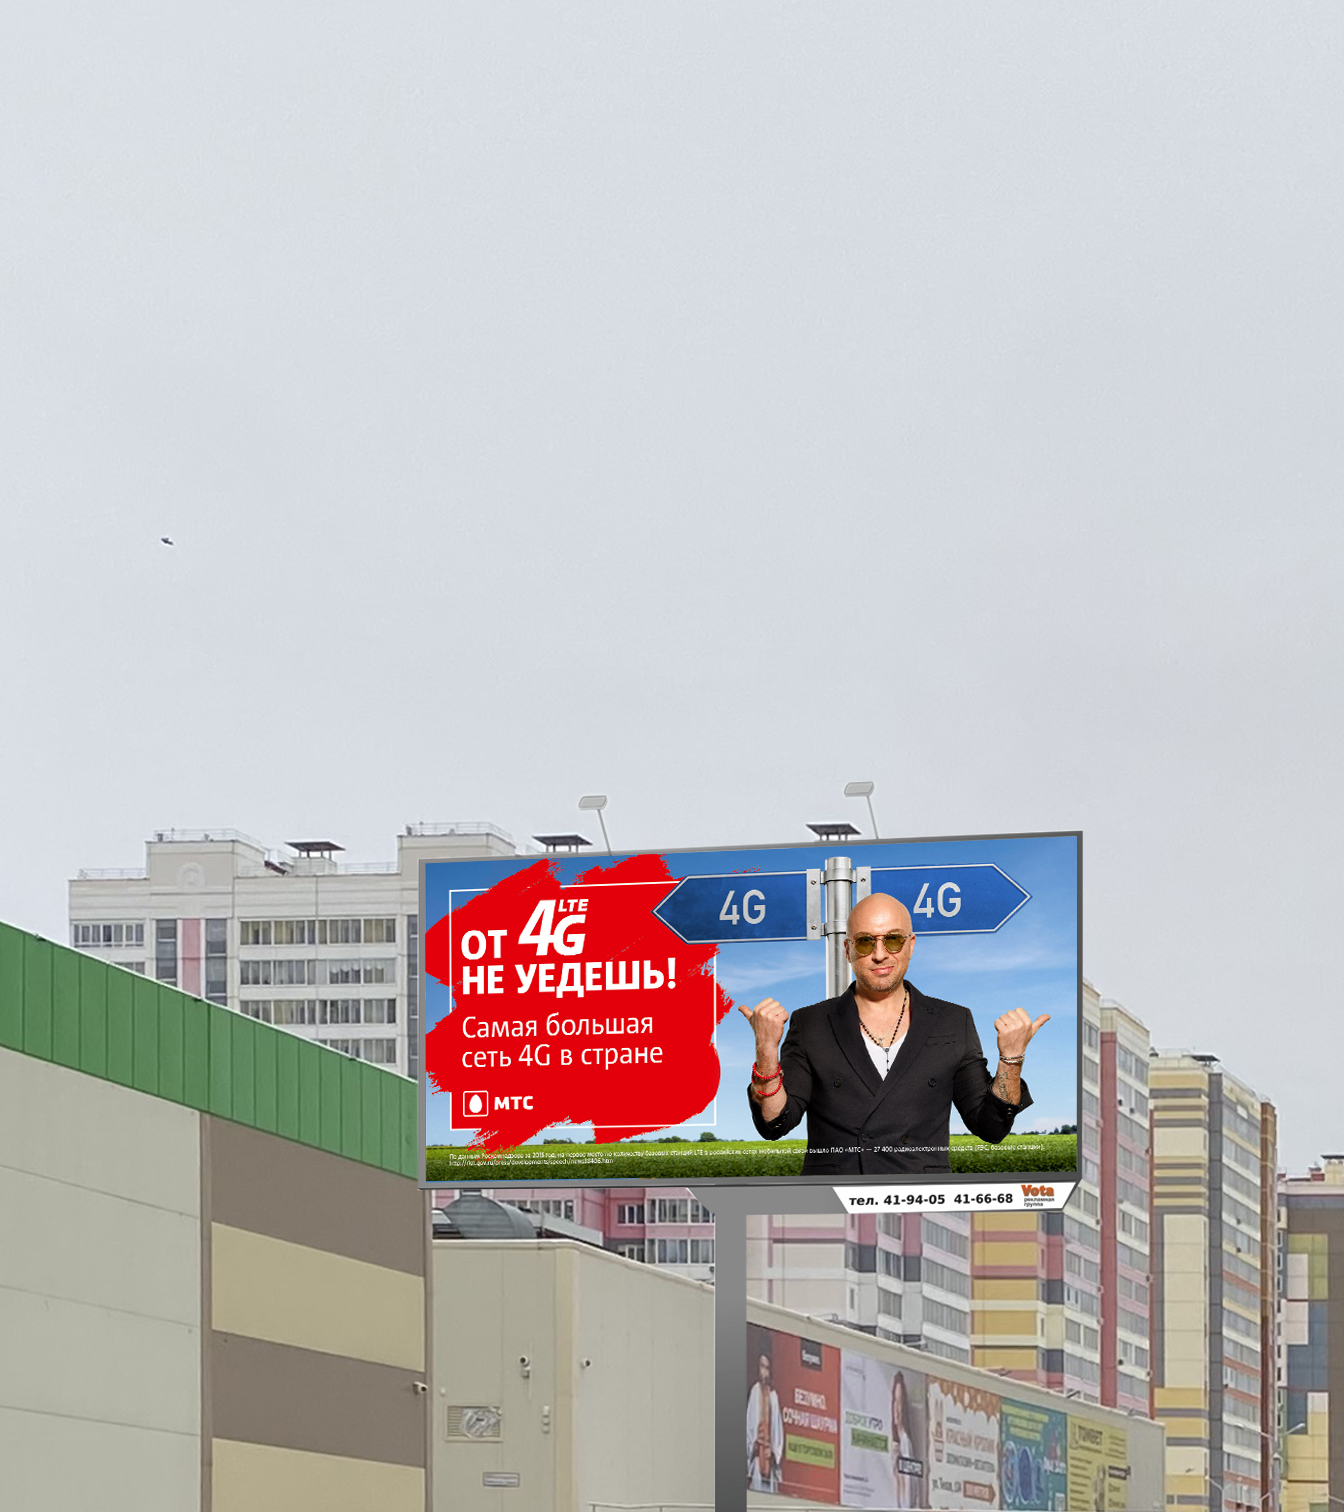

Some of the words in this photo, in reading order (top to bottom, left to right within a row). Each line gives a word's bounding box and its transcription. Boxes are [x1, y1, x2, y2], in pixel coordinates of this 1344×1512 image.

[558, 899, 589, 912] LTE
[719, 889, 766, 926] 4G
[913, 881, 962, 918] 4G
[461, 930, 507, 960] ОТ
[518, 899, 586, 957] 4G
[462, 965, 504, 995] НЕ
[514, 957, 676, 998] УЕДЕШЬ!
[462, 1016, 537, 1038] Самая
[546, 1012, 653, 1036] большая
[462, 1049, 512, 1068] сеть
[518, 1043, 551, 1066] 4G
[560, 1050, 573, 1066] в
[581, 1046, 663, 1070] стране
[849, 1196, 879, 1206] тел.
[883, 1194, 945, 1205] 41-94-05
[953, 1193, 1013, 1204] 41-66-68
[1021, 1184, 1054, 1197] Vota
